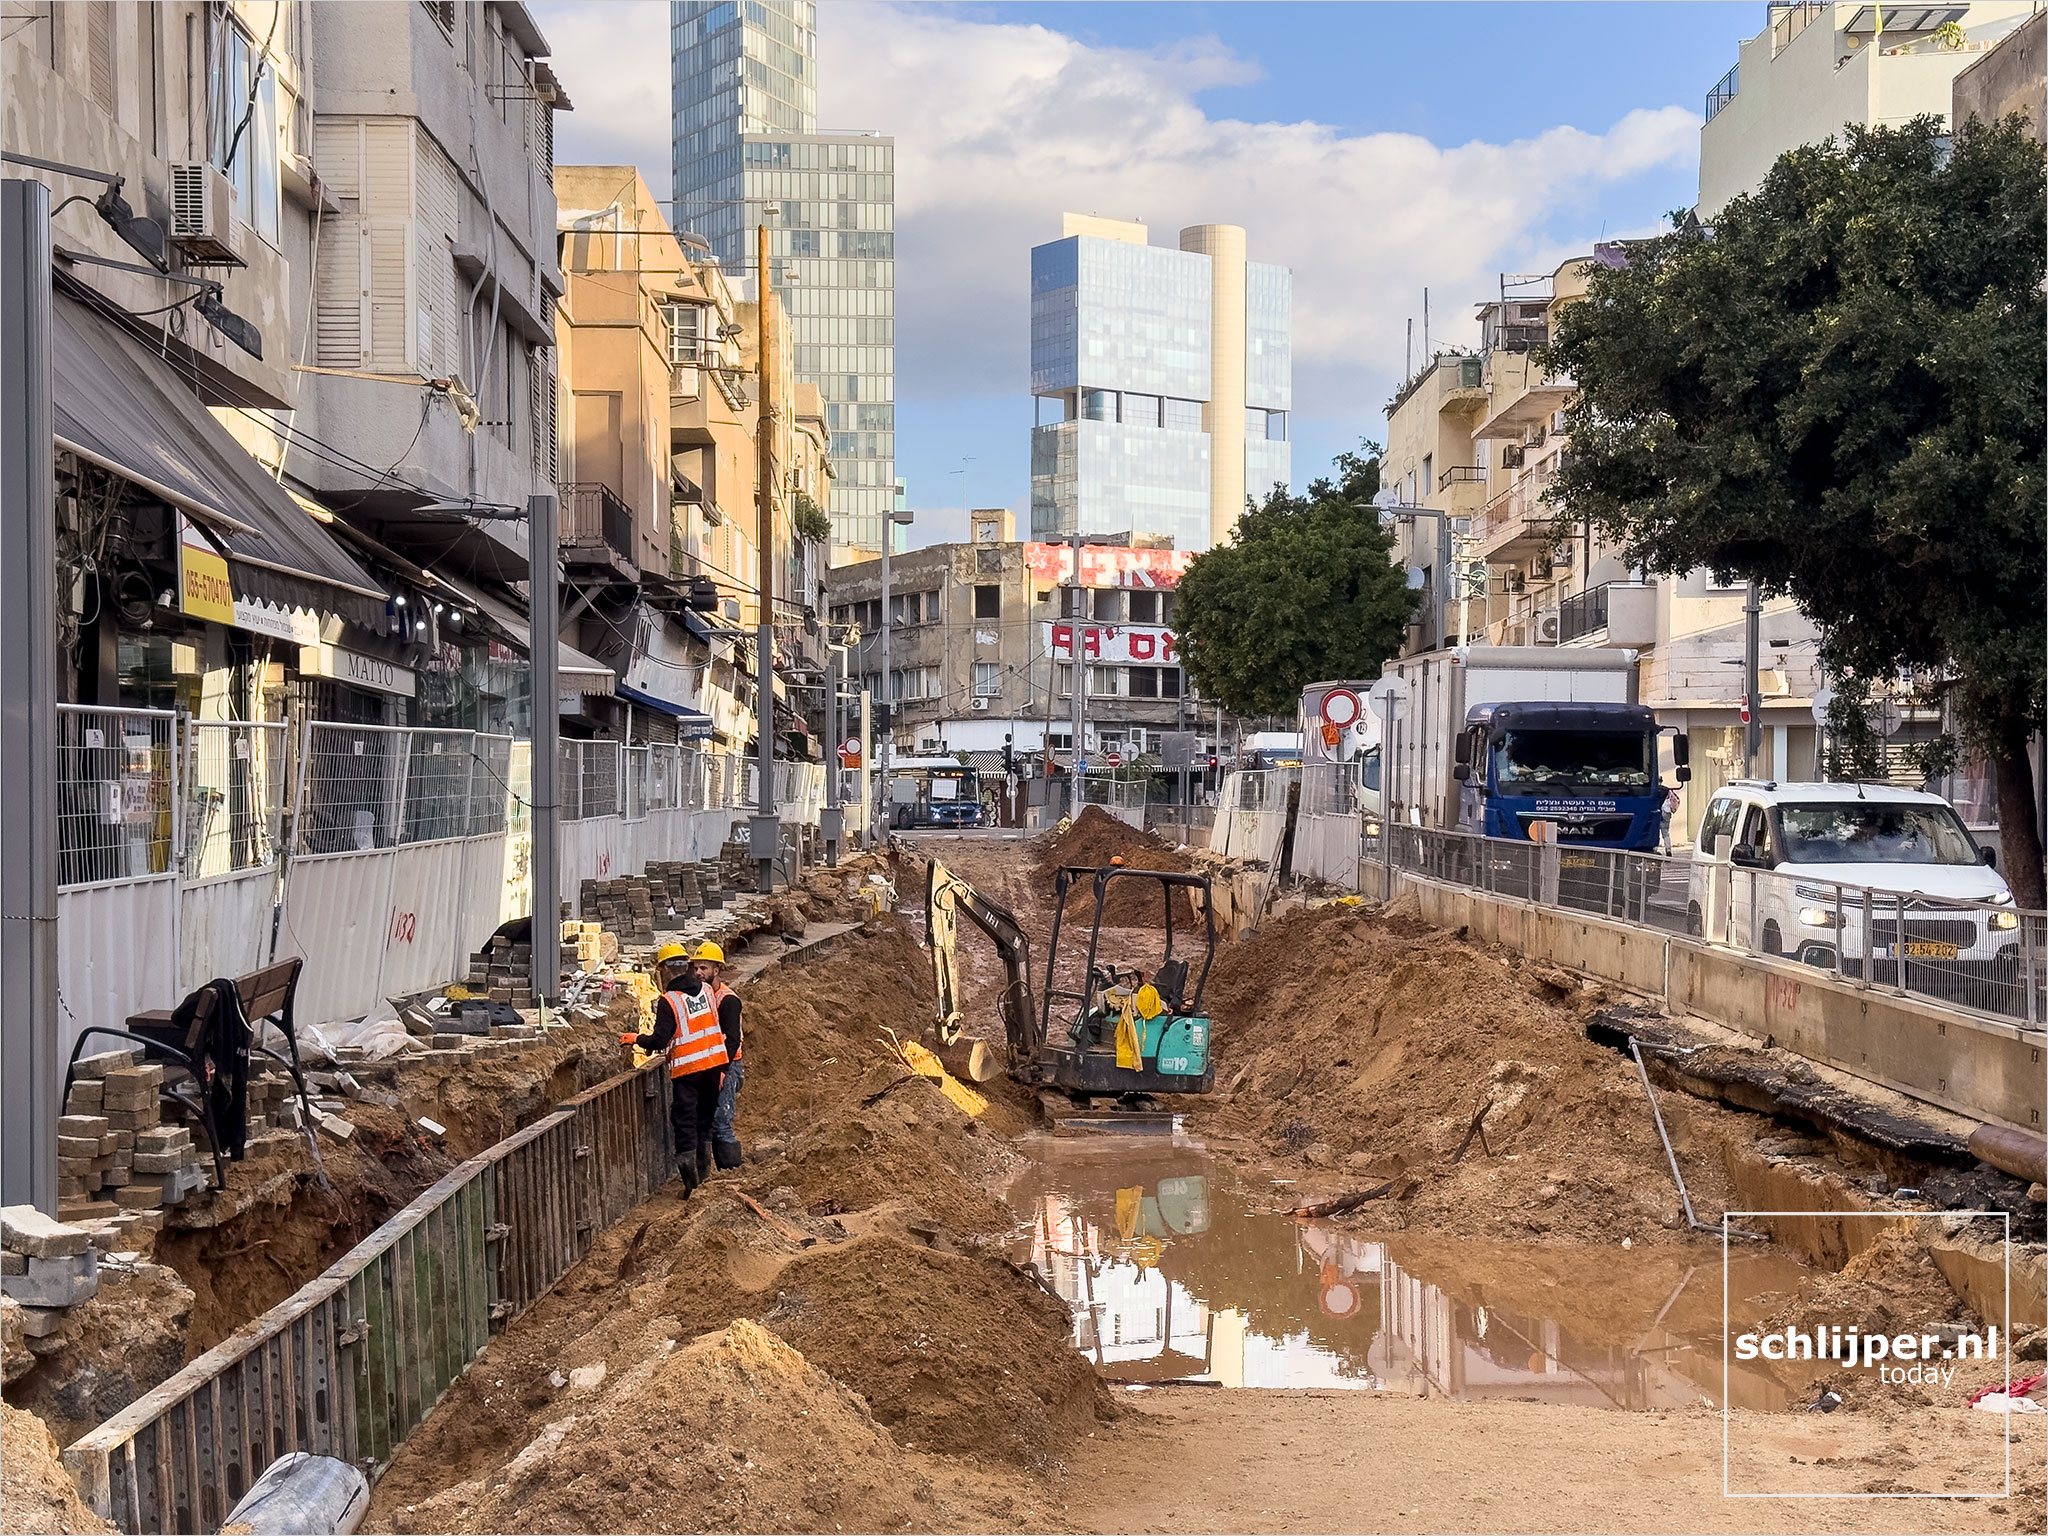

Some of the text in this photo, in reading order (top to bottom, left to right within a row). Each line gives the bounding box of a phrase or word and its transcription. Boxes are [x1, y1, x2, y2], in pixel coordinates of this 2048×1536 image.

[347, 653, 394, 687] MATYO
[1557, 826, 1595, 835] MAN
[1174, 1057, 1188, 1071] 19
